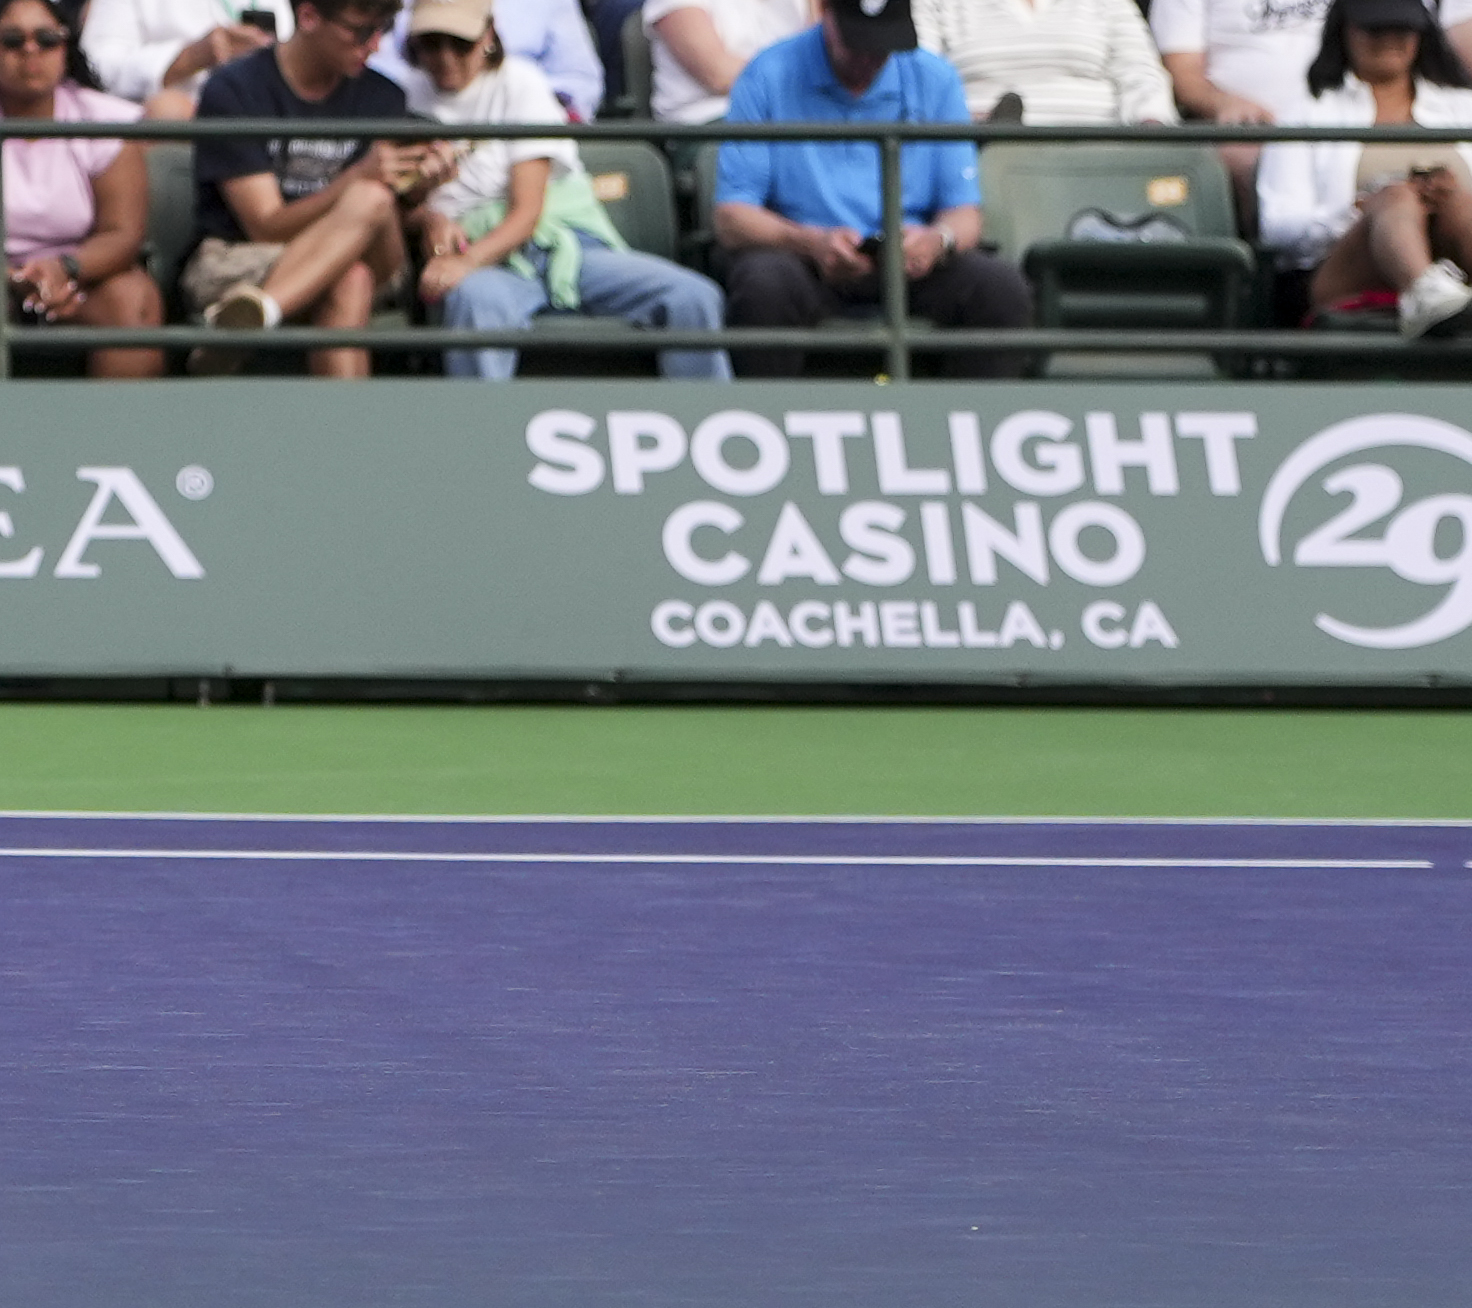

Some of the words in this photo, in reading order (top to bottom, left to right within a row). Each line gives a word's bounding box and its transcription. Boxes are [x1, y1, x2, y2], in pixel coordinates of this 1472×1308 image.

[525, 408, 1258, 496] SPOTLIGHT
[661, 499, 1146, 587] CASINO
[650, 599, 1064, 651] COACHELLA,
[1081, 599, 1179, 649] CA
